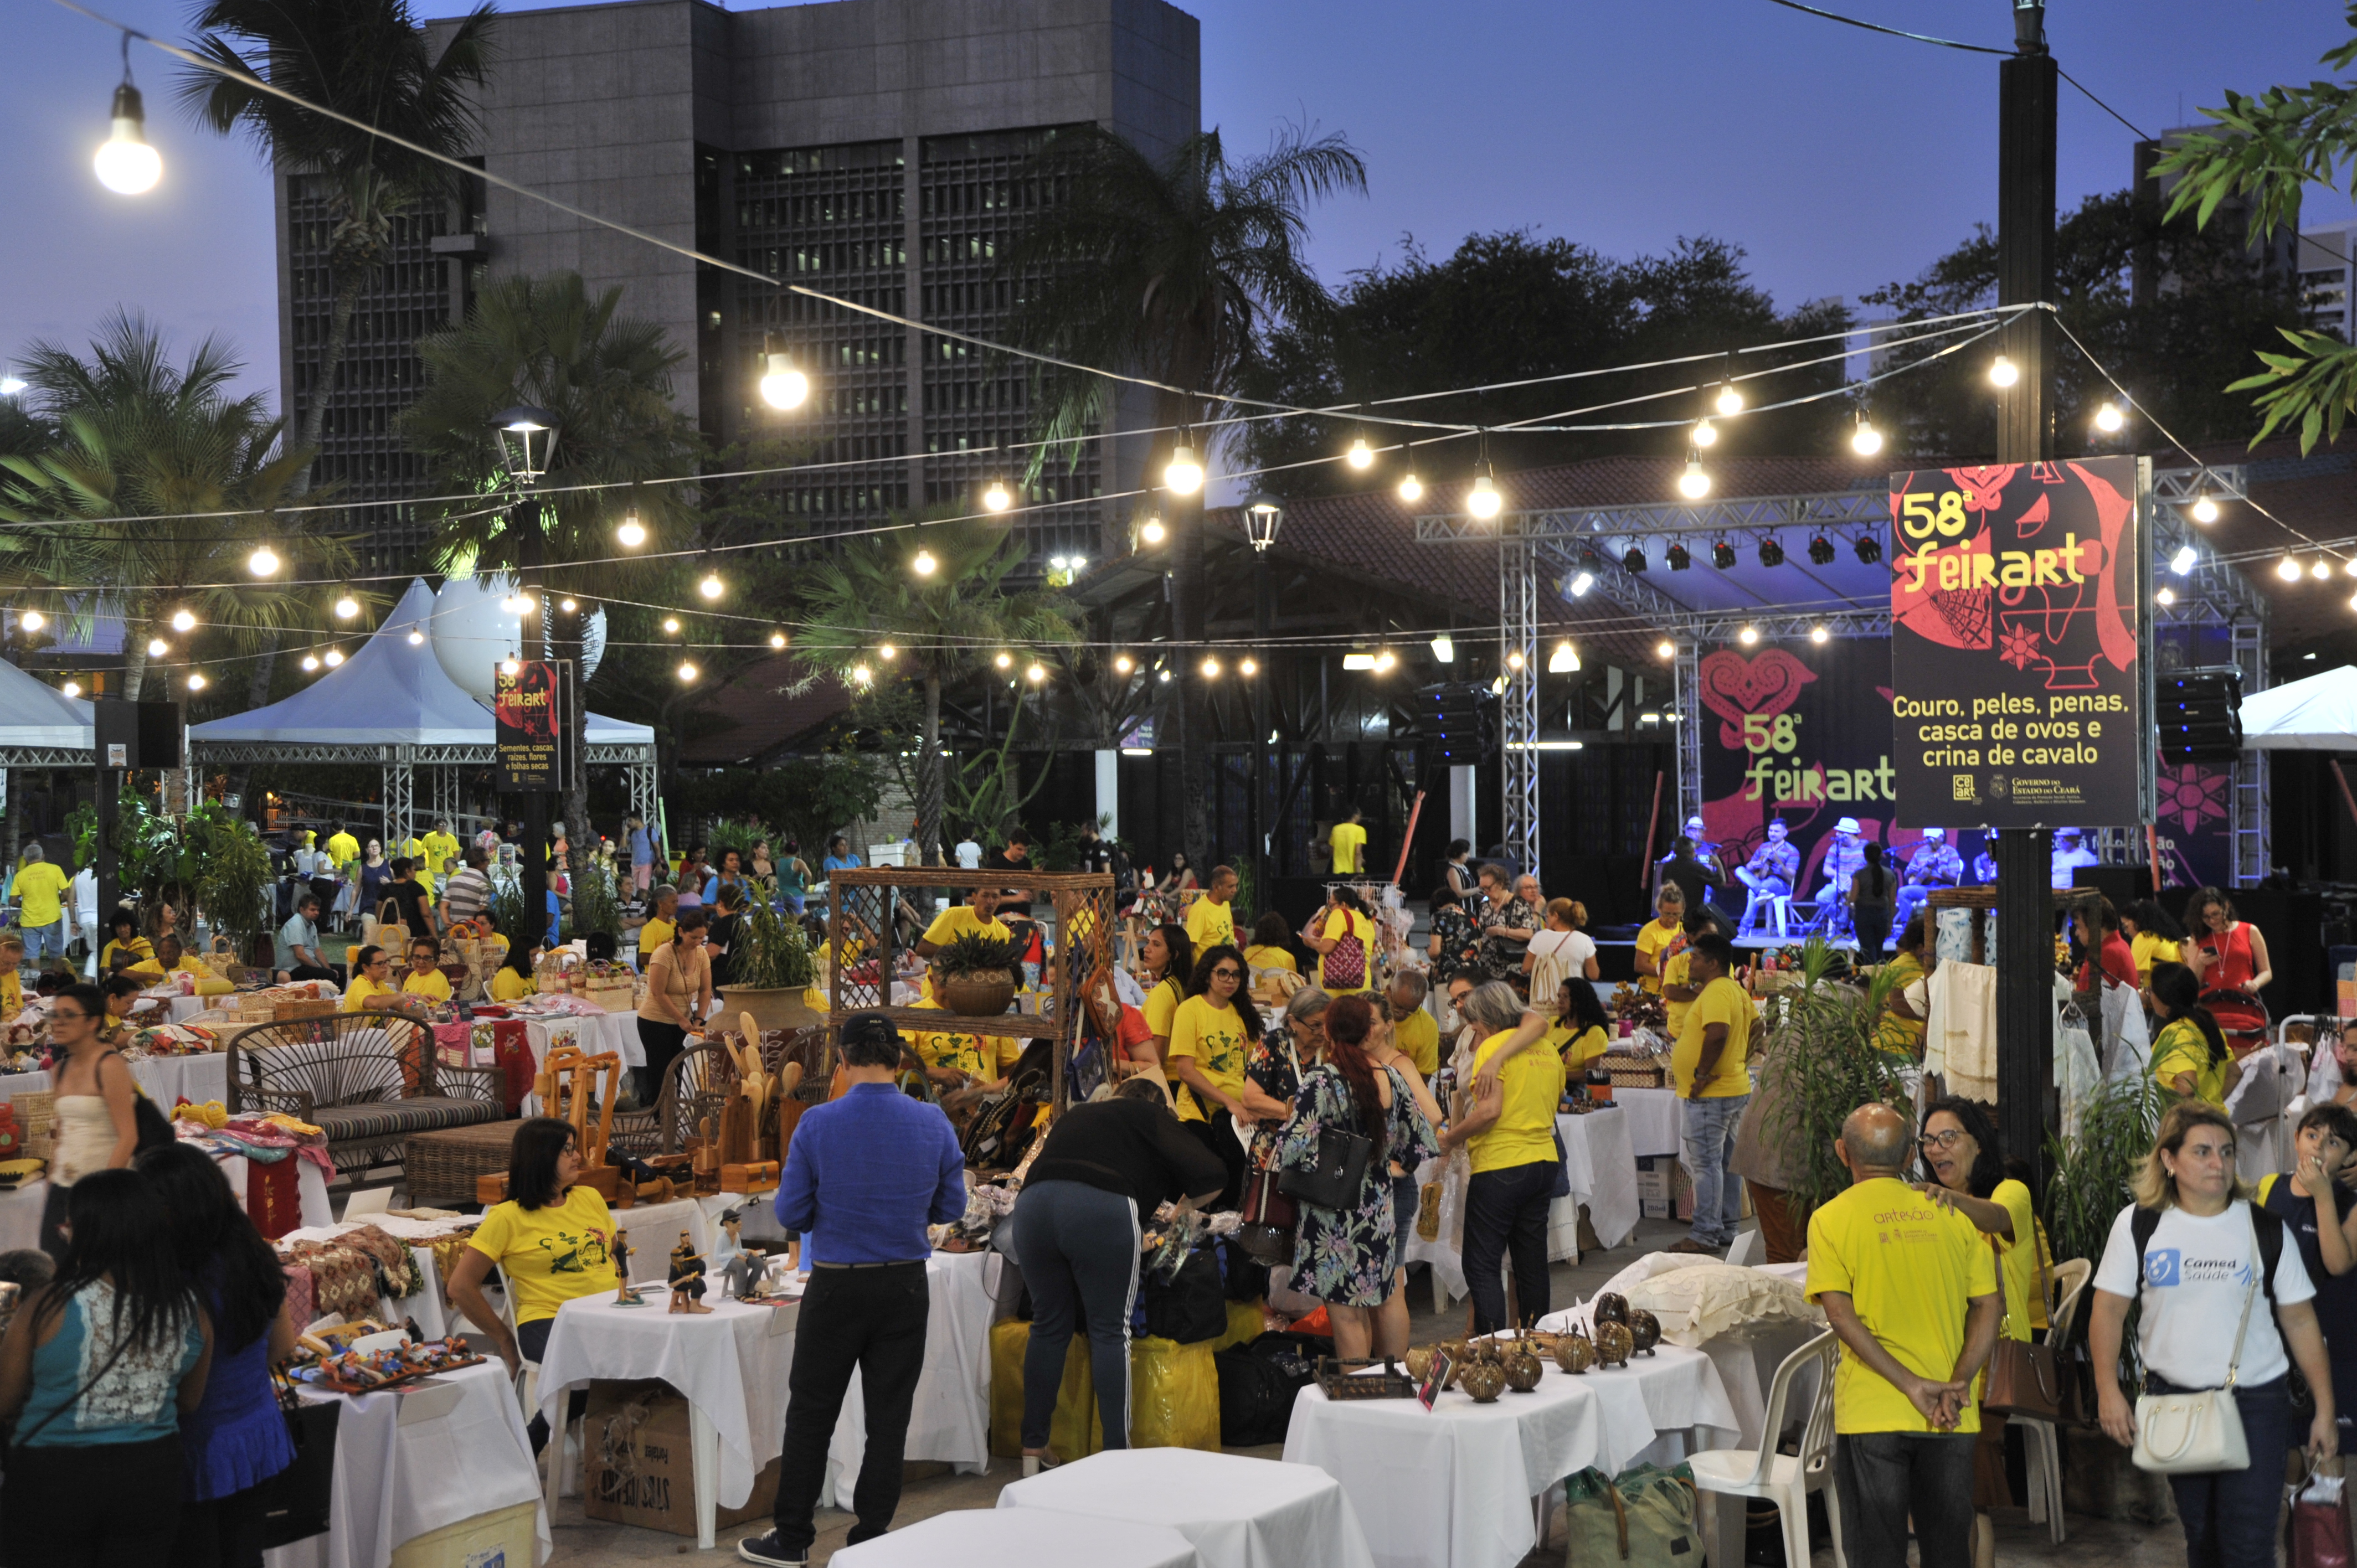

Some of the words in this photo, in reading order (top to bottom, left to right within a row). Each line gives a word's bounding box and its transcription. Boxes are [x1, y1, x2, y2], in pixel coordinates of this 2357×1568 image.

[1893, 695, 1965, 718] Couro,
[1973, 692, 2042, 720] peles,
[2050, 693, 2129, 719] penas,
[1918, 723, 1983, 742] casca
[1990, 718, 2019, 740] de
[2025, 721, 2081, 739] ovos
[2087, 720, 2102, 738] e
[498, 744, 531, 752] Sementes,
[1922, 744, 1980, 767] crina
[1988, 743, 2016, 766] de
[2022, 741, 2098, 765] cavalo
[529, 752, 547, 761] flores
[511, 762, 529, 770] folhas
[2184, 1257, 2236, 1270] Camed
